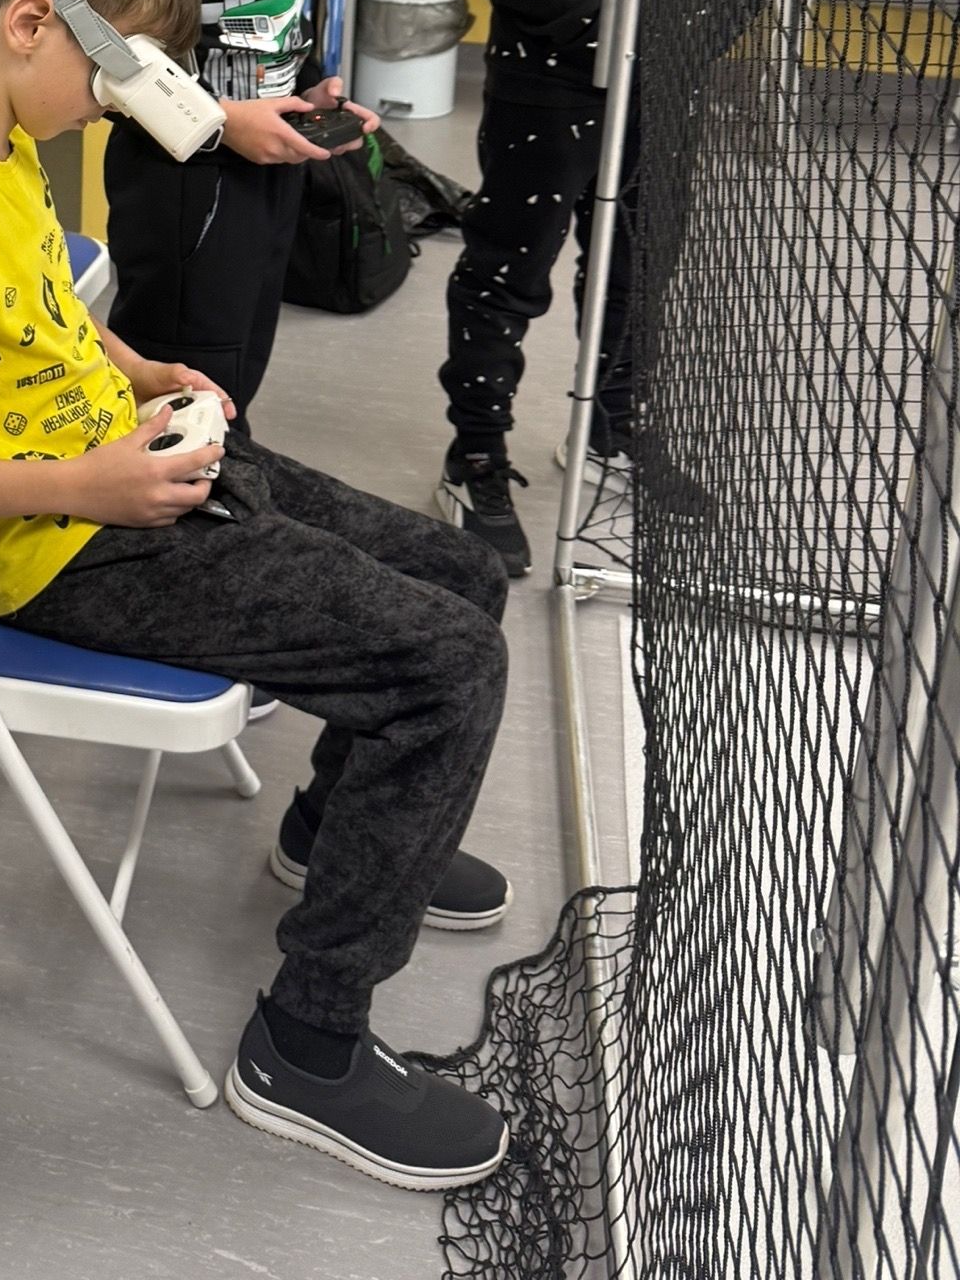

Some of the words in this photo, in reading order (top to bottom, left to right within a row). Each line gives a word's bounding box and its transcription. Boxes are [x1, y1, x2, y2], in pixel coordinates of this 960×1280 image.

[16, 374, 39, 389] JUST
[40, 370, 54, 382] DO
[54, 385, 86, 410] BASKET
